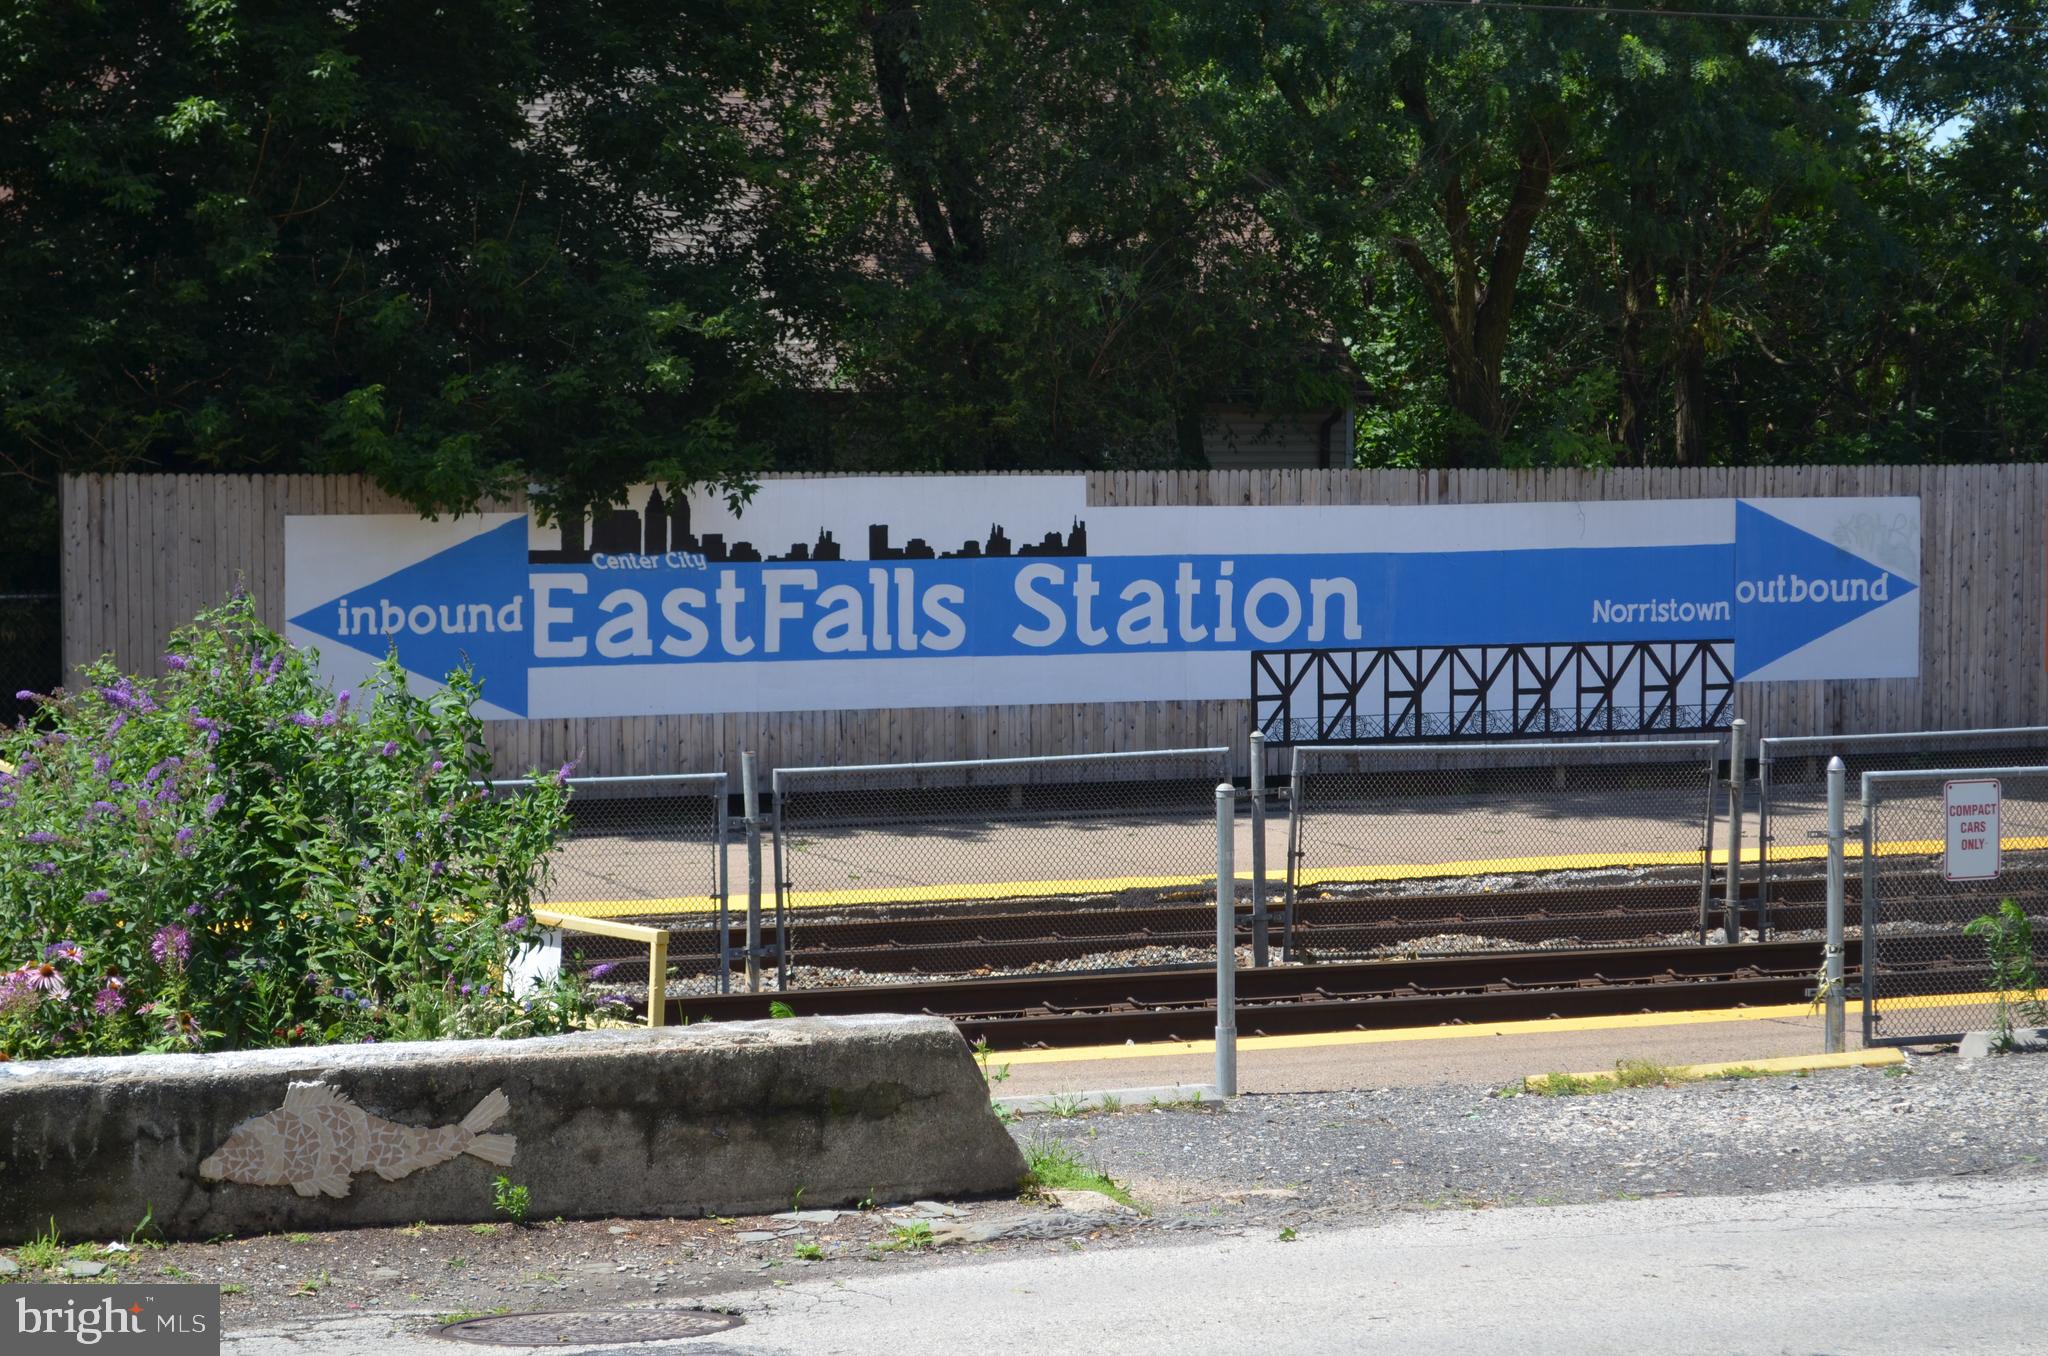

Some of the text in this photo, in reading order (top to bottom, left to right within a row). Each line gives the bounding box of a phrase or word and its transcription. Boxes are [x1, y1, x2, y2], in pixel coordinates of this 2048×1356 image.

[592, 551, 708, 571] Center City
[1736, 571, 1889, 605] outbound
[1013, 558, 1362, 647] Station
[1592, 597, 1732, 625] Norristown
[338, 595, 524, 637] inbound
[1949, 803, 1997, 816] COMPACT
[1960, 821, 1986, 833] CARS
[1961, 838, 1985, 850] ONLY
